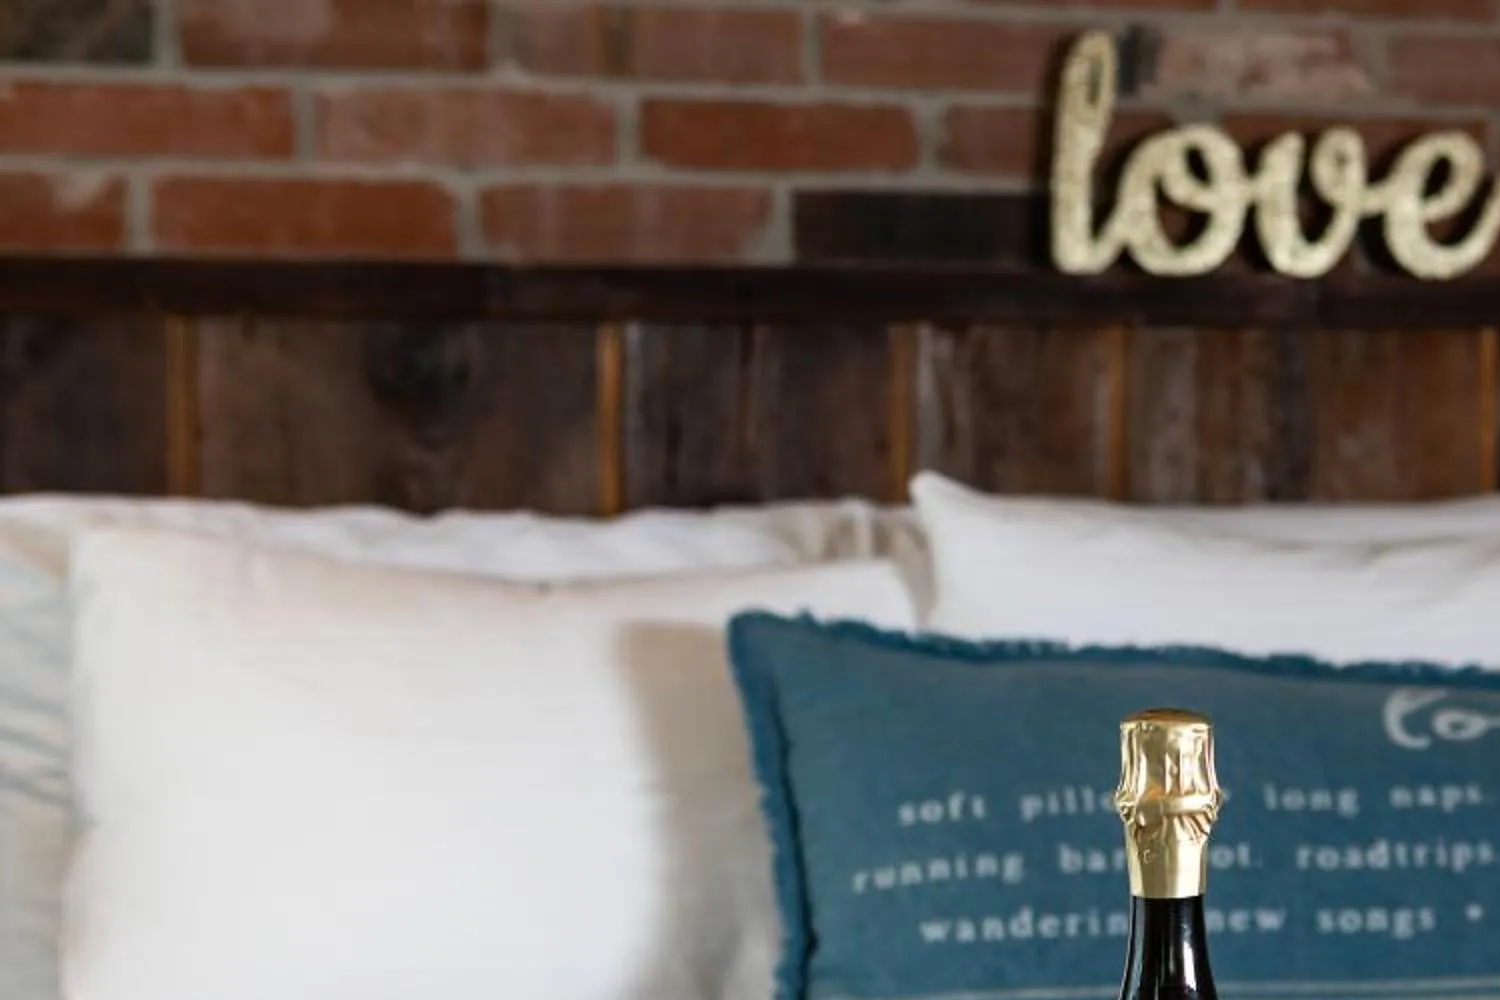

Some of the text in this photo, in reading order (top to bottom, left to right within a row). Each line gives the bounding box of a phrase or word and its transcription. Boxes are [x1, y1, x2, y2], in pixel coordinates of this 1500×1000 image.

[897, 789, 986, 827] soft
[1020, 784, 1118, 823] pillo
[1263, 781, 1360, 818] long
[852, 851, 1024, 893] running
[917, 903, 1128, 944] wanderin
[1203, 906, 1288, 933] new
[1315, 904, 1436, 940] songs
